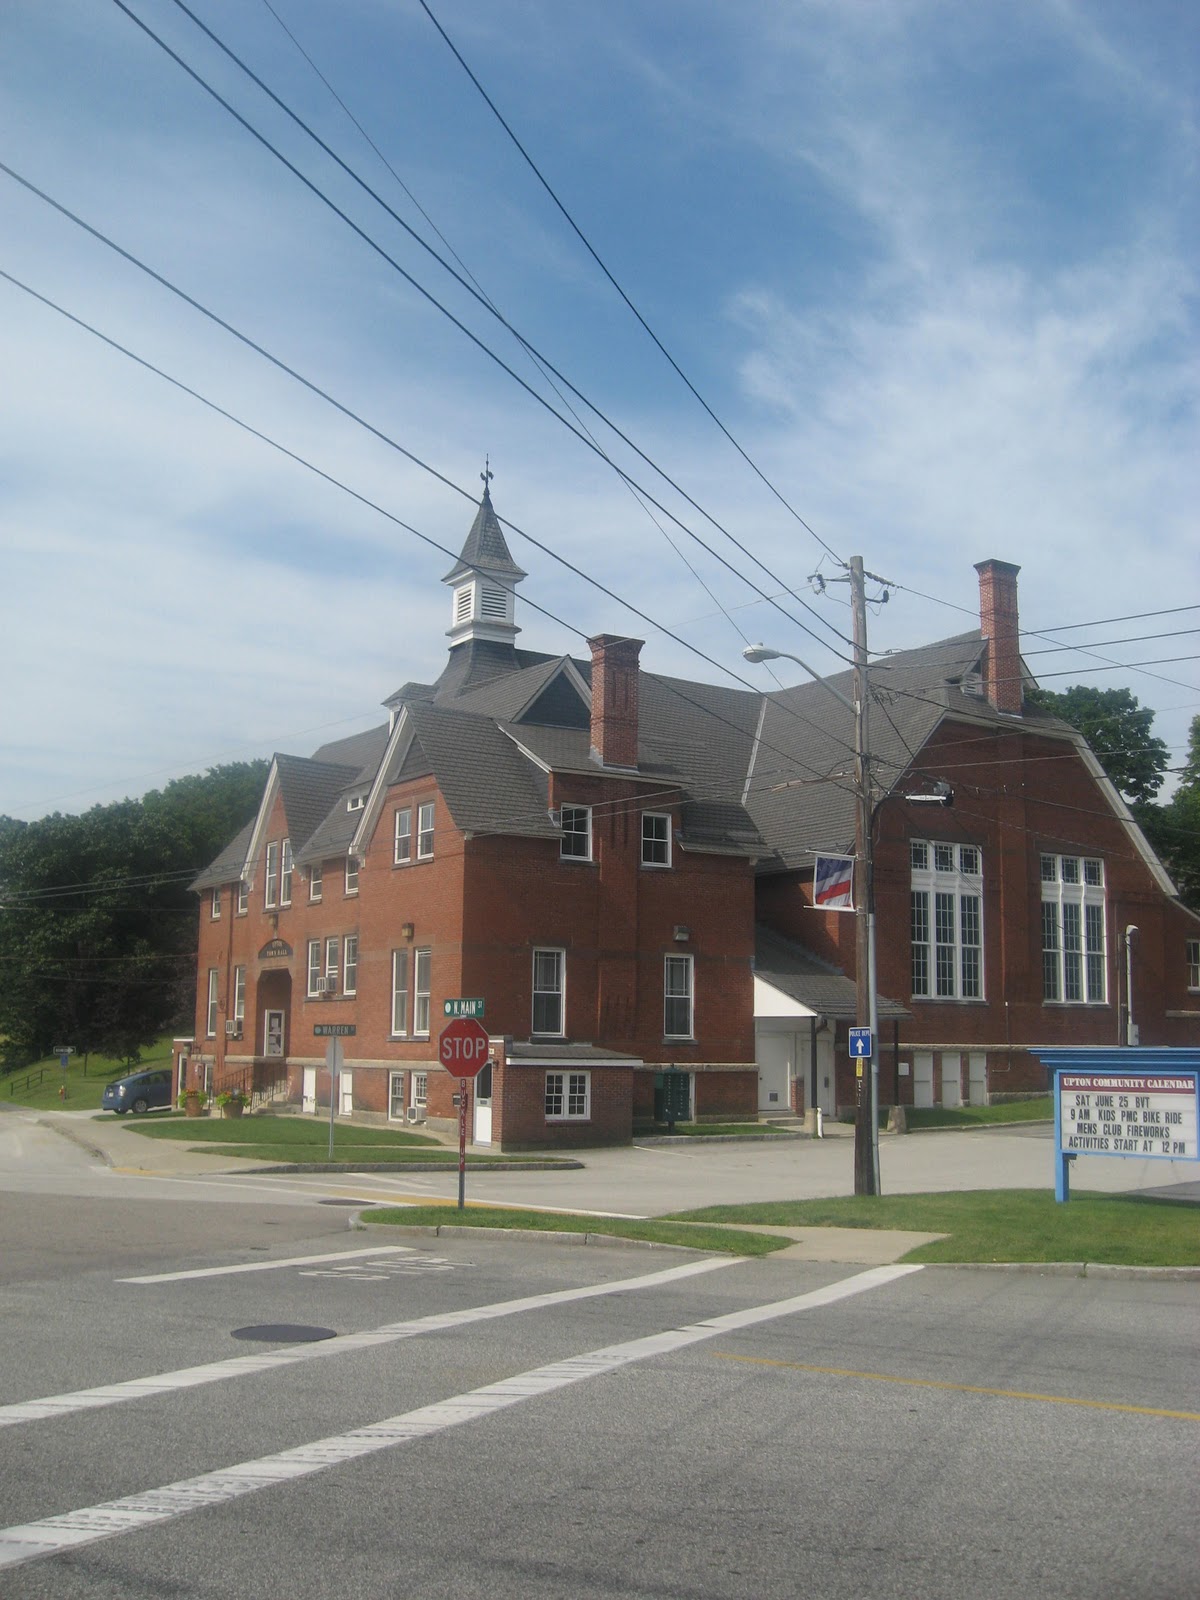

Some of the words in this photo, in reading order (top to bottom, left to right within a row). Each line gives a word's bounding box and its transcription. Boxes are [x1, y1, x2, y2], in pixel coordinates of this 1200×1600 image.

[453, 1001, 459, 1014] N.
[460, 1001, 476, 1014] MAIN
[322, 1026, 349, 1035] WARREN
[442, 1037, 486, 1059] STOP
[1063, 1077, 1091, 1087] UPTON
[1093, 1078, 1145, 1088] COMMUNITY
[1147, 1080, 1194, 1089] CALENDAR
[1075, 1094, 1091, 1107] SAT
[1095, 1095, 1114, 1107] JUNE
[1118, 1096, 1129, 1108] 25
[1135, 1096, 1150, 1109] BVT
[1070, 1108, 1076, 1120] 9
[1078, 1109, 1090, 1121] AM
[1098, 1110, 1116, 1122] KIDS
[1121, 1111, 1138, 1123] PMC
[1142, 1112, 1161, 1124] BIKE
[1164, 1112, 1183, 1125] RIDE
[1076, 1122, 1098, 1135] MENS
[1102, 1123, 1122, 1136] CLUB
[1126, 1124, 1170, 1139] FIREWORKS
[1068, 1136, 1109, 1150] ACTIVITIES
[1113, 1139, 1138, 1151] START
[1142, 1140, 1153, 1152] AT
[1161, 1141, 1170, 1154] 12
[1173, 1142, 1186, 1154] PM
